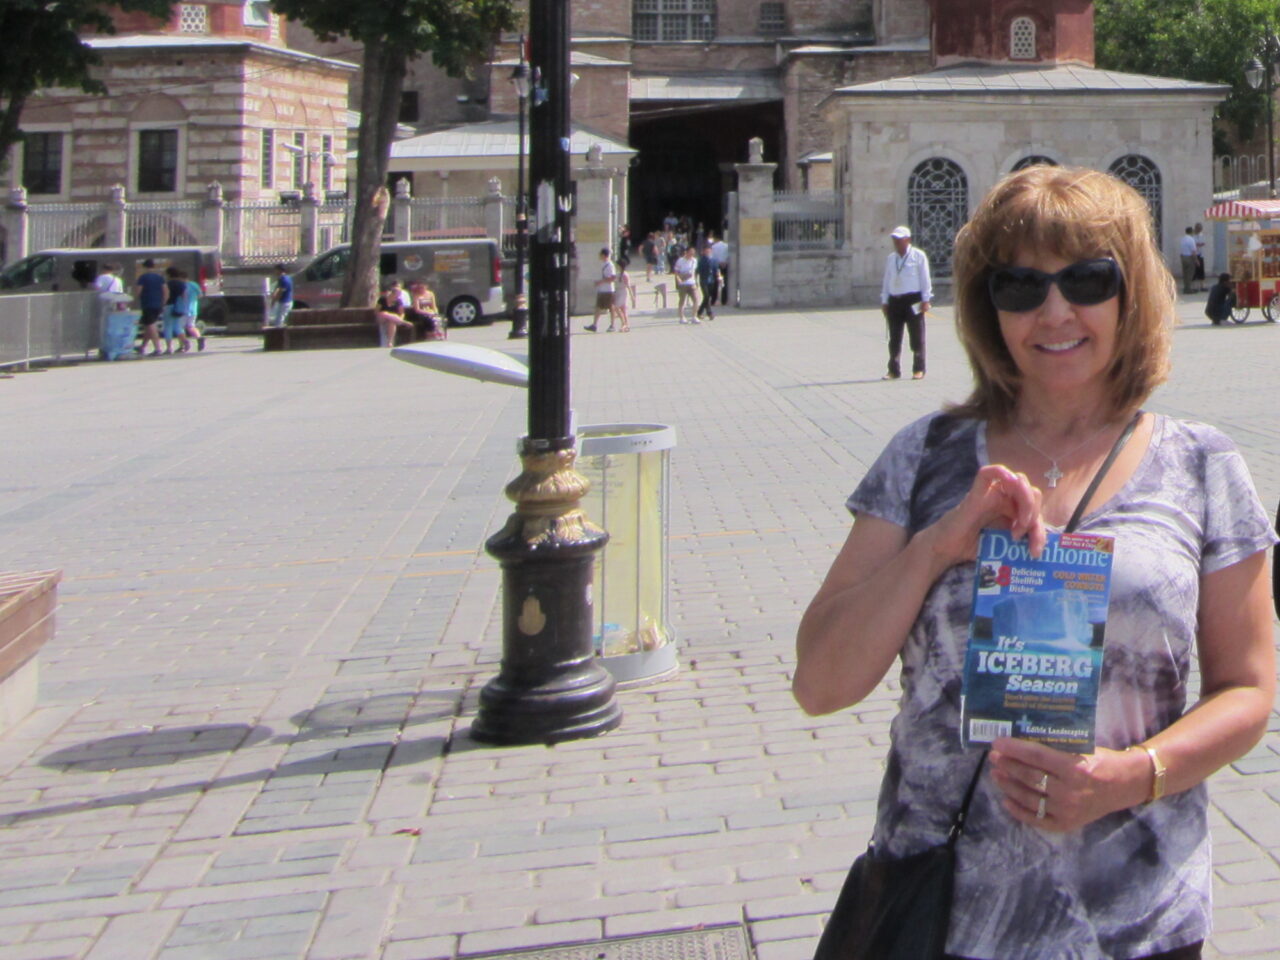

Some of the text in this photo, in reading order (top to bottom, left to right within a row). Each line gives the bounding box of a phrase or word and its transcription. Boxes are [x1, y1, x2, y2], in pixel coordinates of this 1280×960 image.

[987, 533, 1110, 567] Downhome
[996, 565, 1011, 587] 8
[1011, 567, 1046, 577] Delicious
[1009, 584, 1035, 593] Dishes
[1011, 575, 1043, 586] Shellfish
[997, 636, 1025, 652] It's
[977, 651, 1094, 678] ICEBERG
[1006, 675, 1079, 694] Season
[1048, 727, 1089, 738] Landscaping
